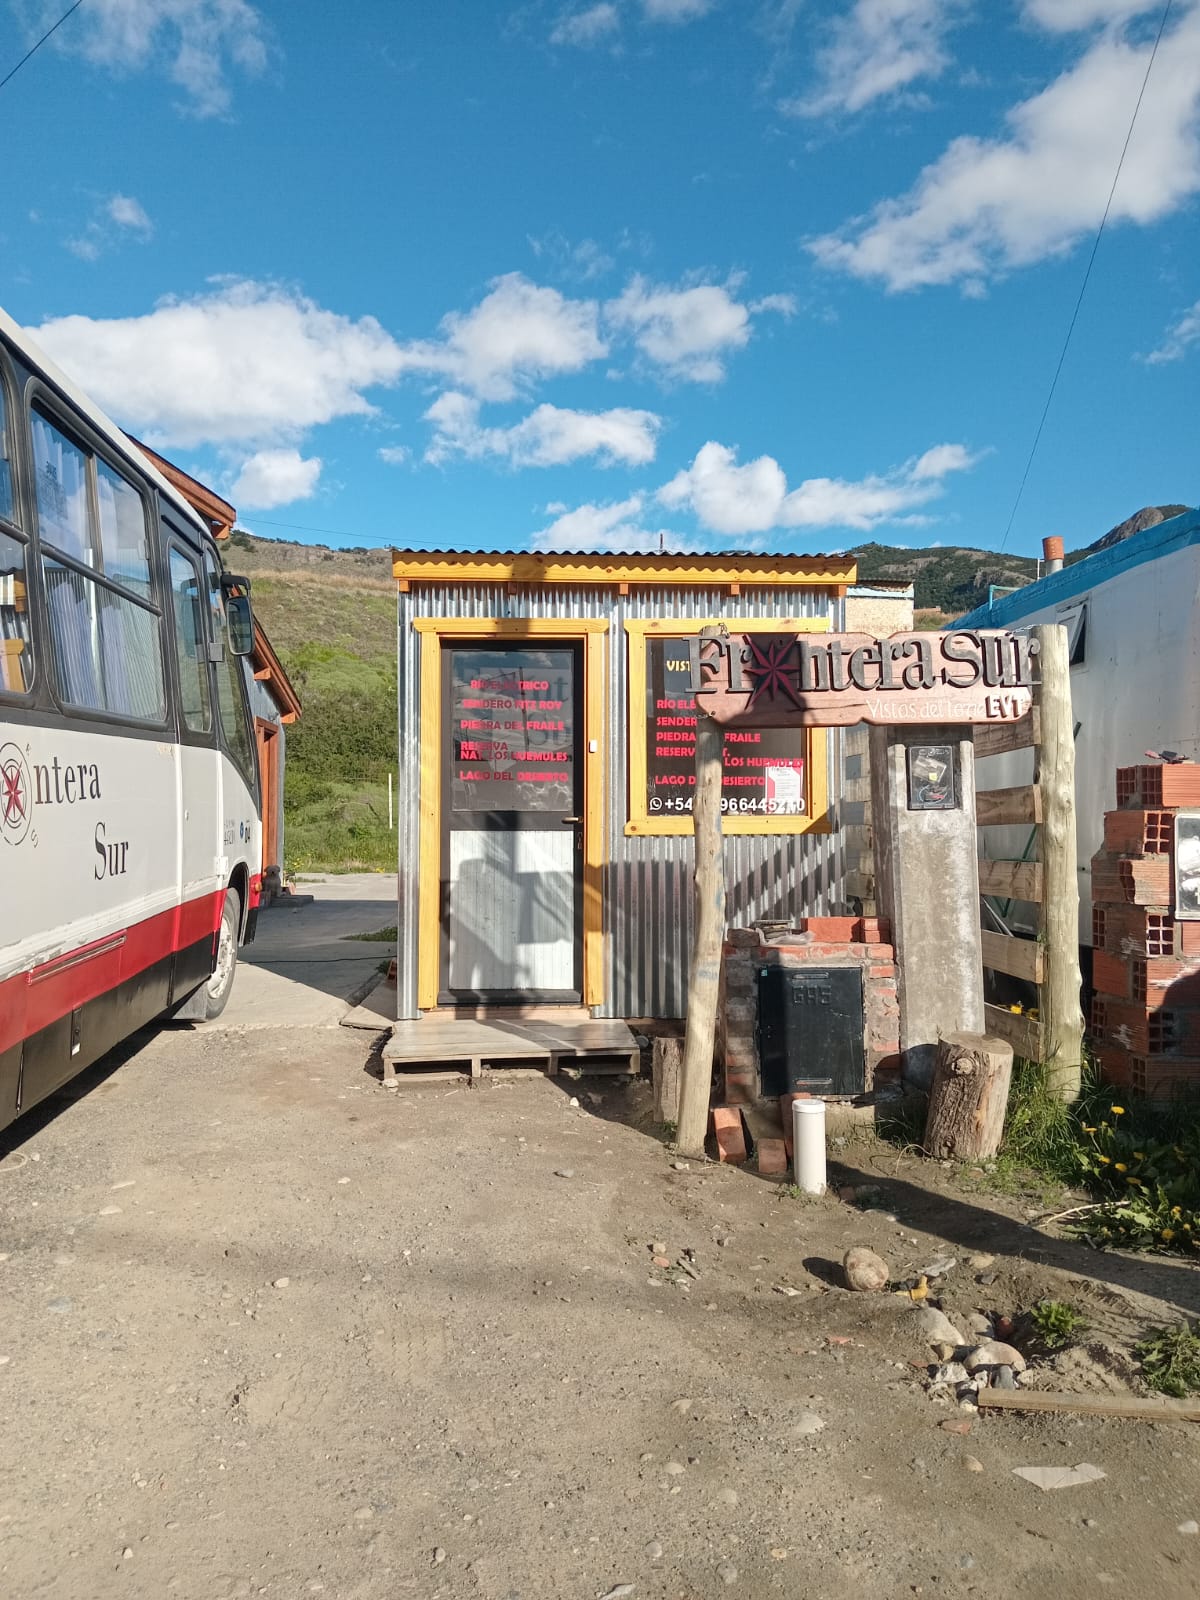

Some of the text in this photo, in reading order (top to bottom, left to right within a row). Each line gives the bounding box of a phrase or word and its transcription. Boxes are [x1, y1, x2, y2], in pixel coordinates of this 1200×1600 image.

[683, 629, 1043, 693] Frntera Sur
[463, 699, 513, 710] SENDERO
[539, 701, 563, 711] ROY
[985, 695, 1024, 718] EVT
[460, 720, 565, 731] PIEDRA DEL FRAILE
[655, 731, 697, 742] PIEDRA
[460, 741, 509, 751] RESERVA
[489, 751, 508, 761] LOS
[511, 751, 569, 761] HUEMULES
[724, 757, 744, 767] LOS
[459, 770, 569, 782] LAGO DEL DESIERTO
[655, 775, 686, 786] LAGO
[721, 775, 766, 787] ESIERTO
[94, 821, 129, 881] Sur
